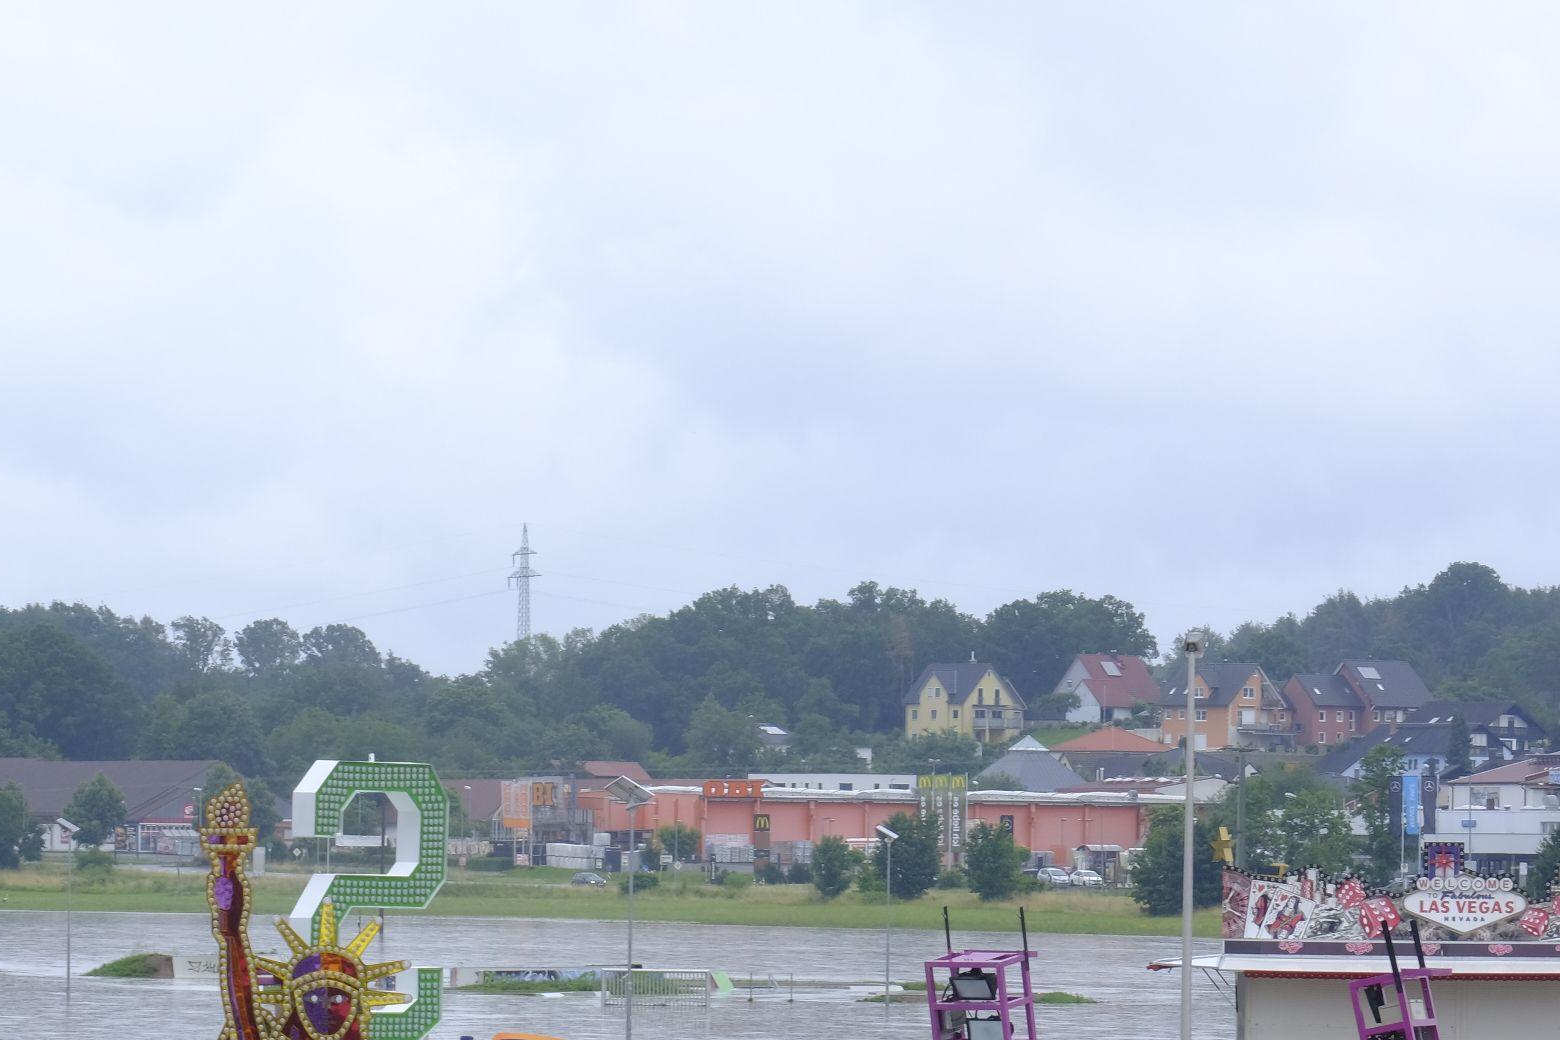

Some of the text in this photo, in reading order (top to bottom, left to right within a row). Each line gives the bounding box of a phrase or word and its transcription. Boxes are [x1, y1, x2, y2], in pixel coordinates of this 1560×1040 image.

[532, 782, 553, 806] BI
[703, 779, 765, 798] OBI
[1419, 878, 1512, 890] WELCOME
[1440, 890, 1495, 900] Fabulous
[1419, 900, 1514, 914] LAS VEGAS
